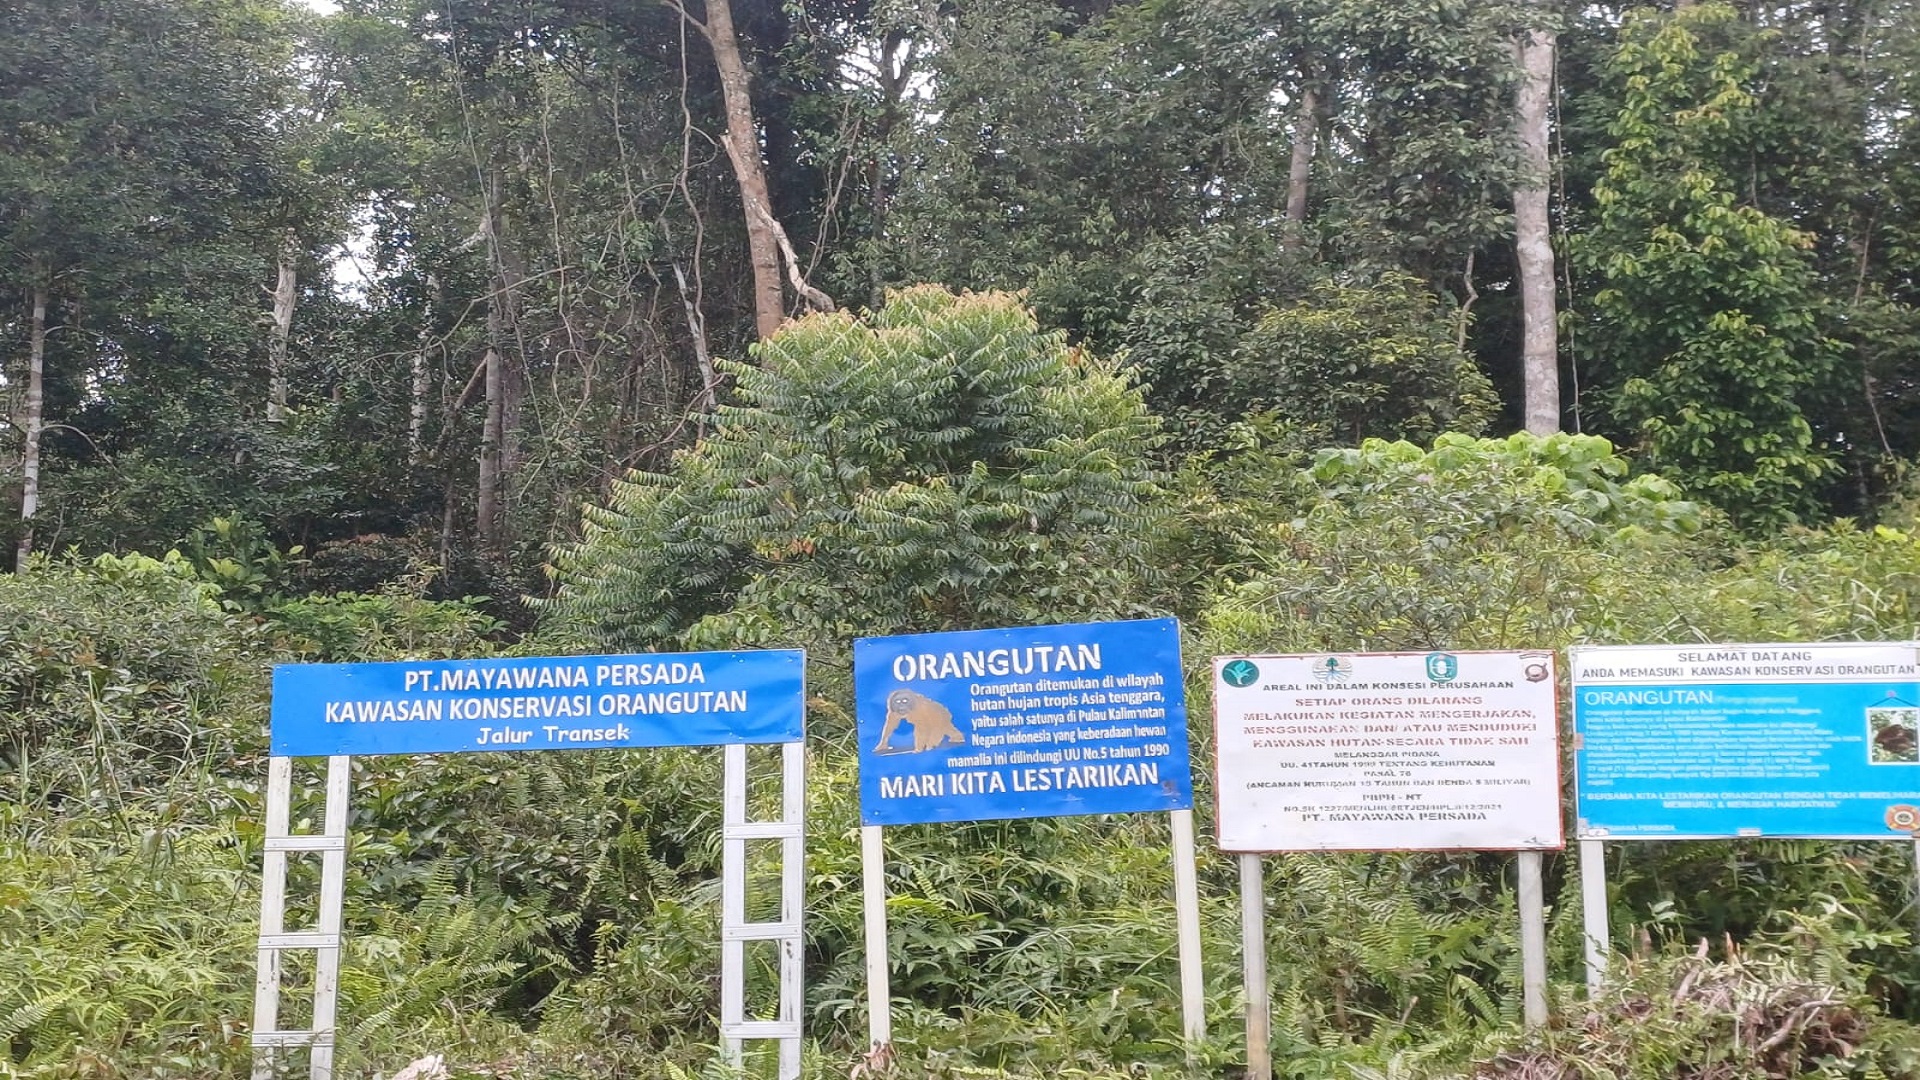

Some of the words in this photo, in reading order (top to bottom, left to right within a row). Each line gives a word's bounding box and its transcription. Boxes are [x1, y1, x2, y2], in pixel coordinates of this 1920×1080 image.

[894, 644, 1101, 681] ORANGUTAN
[1678, 652, 1746, 662] SELAMAT
[1752, 652, 1811, 661] DATANG
[405, 666, 589, 691] PT.MAYAWANA
[597, 663, 705, 686] PERSADA
[1582, 668, 1614, 678] ANDA
[1620, 668, 1683, 677] MEMASUKI
[1691, 666, 1750, 676] KAWASAN
[1755, 666, 1834, 675] KONSERVASI
[1838, 665, 1914, 675] ORANGUTAN
[971, 682, 1032, 697] Orangutan
[1036, 677, 1099, 692] ditemukan
[1102, 675, 1114, 688] di
[1116, 673, 1163, 688] wilayah
[1430, 680, 1513, 689] PERUSAHAAN
[326, 700, 442, 722] KAWASAN
[450, 695, 591, 719] KONSERVASI
[599, 691, 746, 715] ORANGUTAN
[971, 698, 1006, 711] hutan
[1008, 696, 1041, 711] hujan
[1044, 693, 1078, 708] tropis
[1081, 692, 1105, 704] Asia
[1108, 690, 1165, 705] tenggara,
[1296, 698, 1346, 706] SETIAP
[1352, 697, 1402, 705] ORANG
[1408, 697, 1482, 705] DILARANG
[1585, 690, 1714, 705] ORANGUTAN
[971, 715, 997, 730] yaitu
[999, 713, 1024, 727] salah
[1026, 713, 1065, 726] satunya
[1067, 710, 1076, 722] di
[1079, 709, 1107, 722] Pulau
[1340, 711, 1414, 719] KEGIATAN
[477, 726, 533, 744] Jalur
[543, 723, 629, 742] Transek
[972, 734, 1005, 748] Negara
[1006, 729, 1051, 744] Indonesia
[1053, 731, 1075, 744] yang
[1077, 726, 1132, 739] keberadaan
[1134, 725, 1166, 737] hewan
[1244, 725, 1357, 734] MENGGUNAKAN
[1403, 724, 1442, 732] ATAU
[1254, 739, 1325, 747] KAWASAN
[1449, 737, 1493, 745] TIDAK
[948, 753, 992, 767] mamalia
[993, 752, 1007, 765] ini
[1010, 749, 1062, 764] dilindungi
[1064, 748, 1080, 761] UU
[1083, 747, 1107, 759] No.5
[1108, 745, 1141, 758] tahun
[1144, 744, 1169, 756] 1990
[881, 775, 943, 798] MARI
[951, 771, 1006, 794] KITA
[1013, 763, 1158, 791] LESTARIKAN
[1330, 813, 1414, 821] MAYAWANA
